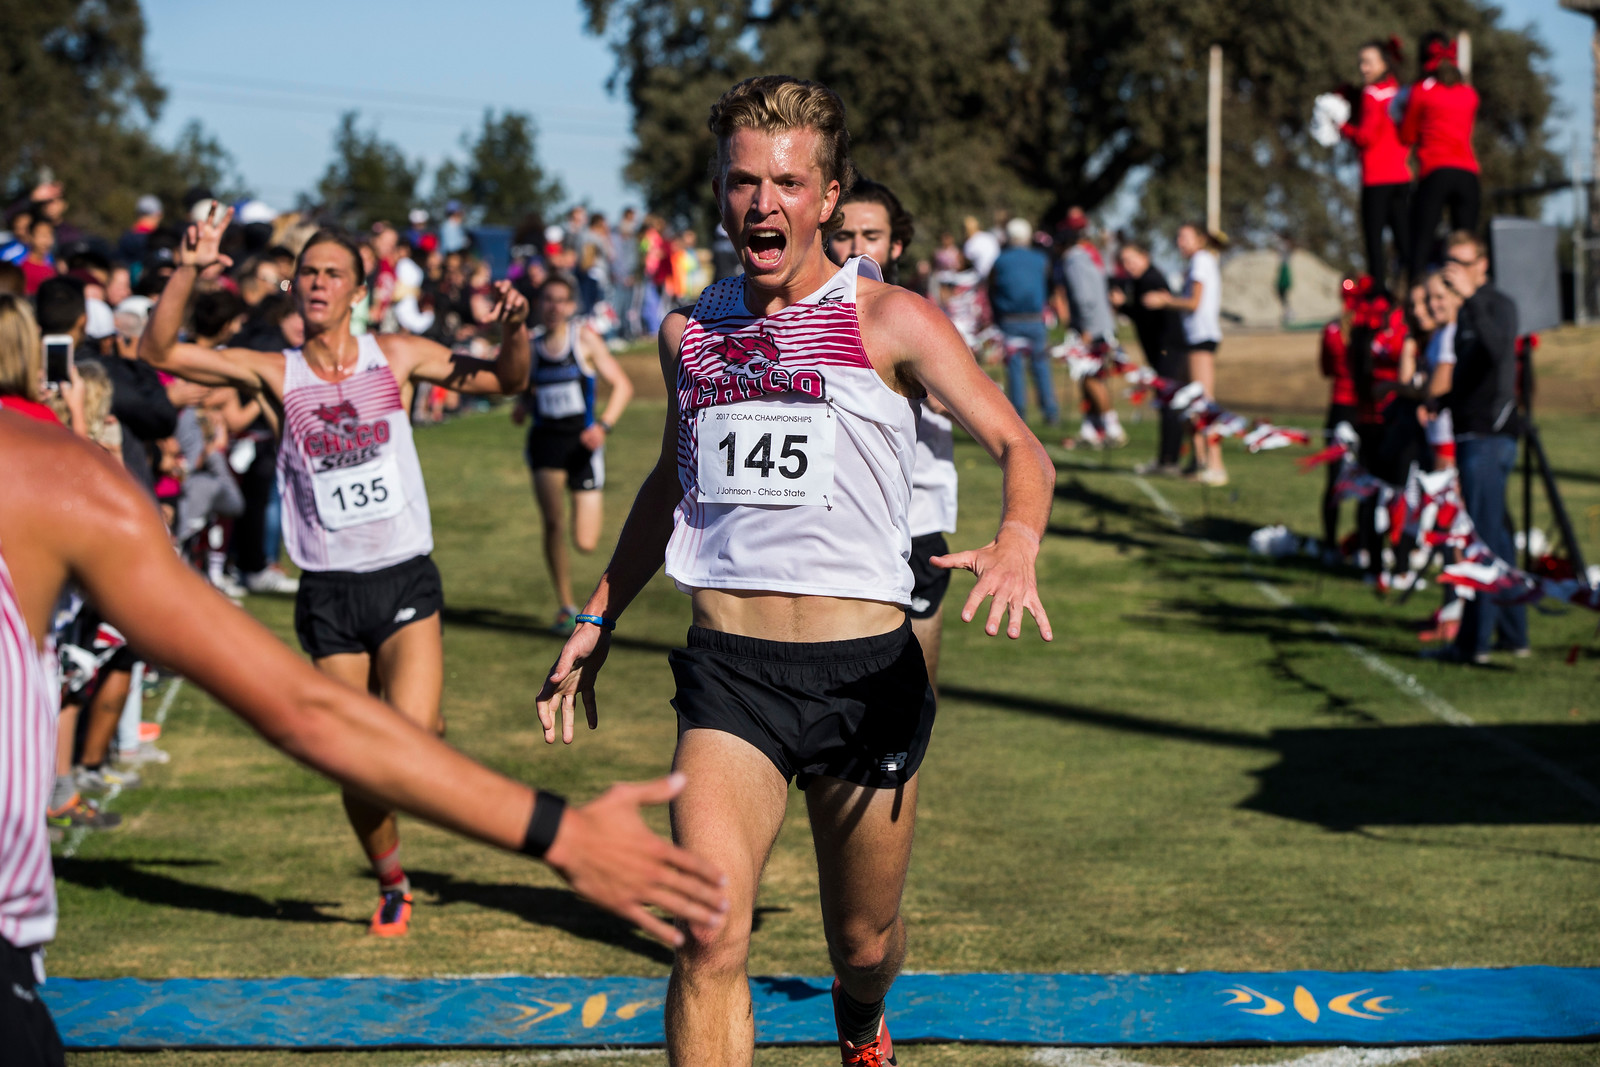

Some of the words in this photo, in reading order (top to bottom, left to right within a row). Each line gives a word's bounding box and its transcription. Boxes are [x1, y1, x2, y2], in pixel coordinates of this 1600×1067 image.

[690, 367, 826, 409] CHICO
[715, 413, 730, 421] 2017
[731, 413, 753, 421] CCAA
[754, 414, 812, 423] CHAMPIONSHIPS
[304, 420, 389, 457] CHICO
[719, 432, 808, 480] 145
[332, 478, 388, 511] 135
[716, 487, 720, 495] J
[721, 487, 751, 496] Johnson
[758, 487, 782, 497] Chico
[783, 488, 806, 497] State
